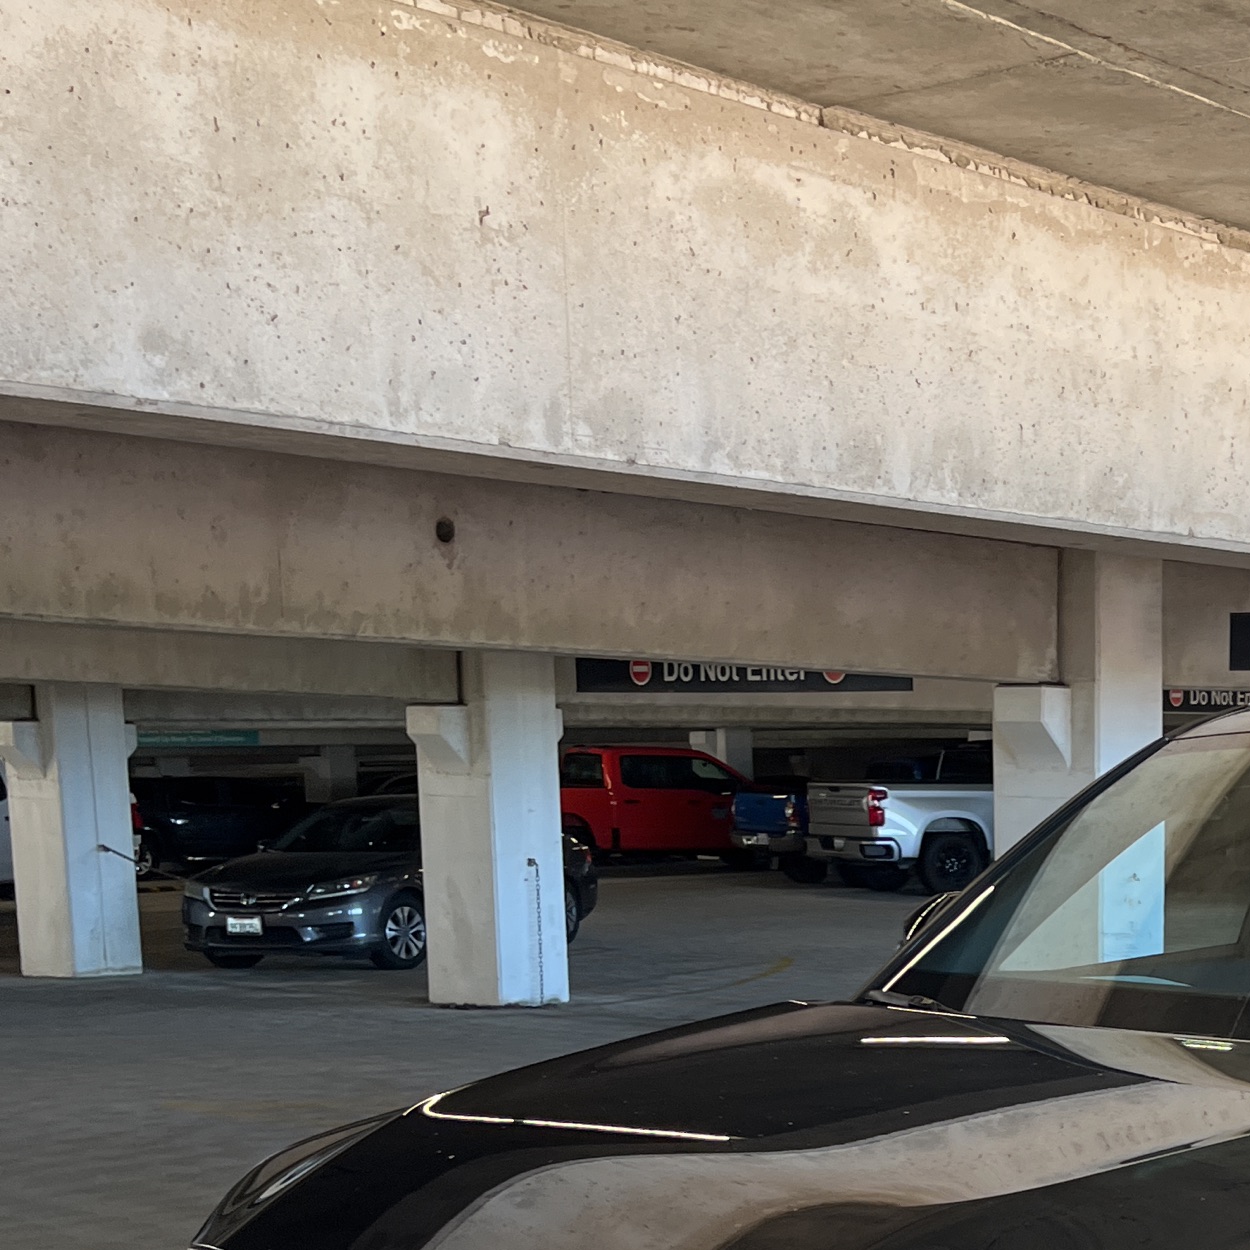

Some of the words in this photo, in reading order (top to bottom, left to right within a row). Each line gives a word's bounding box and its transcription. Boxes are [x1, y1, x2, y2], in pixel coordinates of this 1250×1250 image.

[662, 661, 693, 682] Do
[700, 664, 740, 682] Not
[1189, 690, 1209, 705] Do
[1211, 690, 1234, 705] Not
